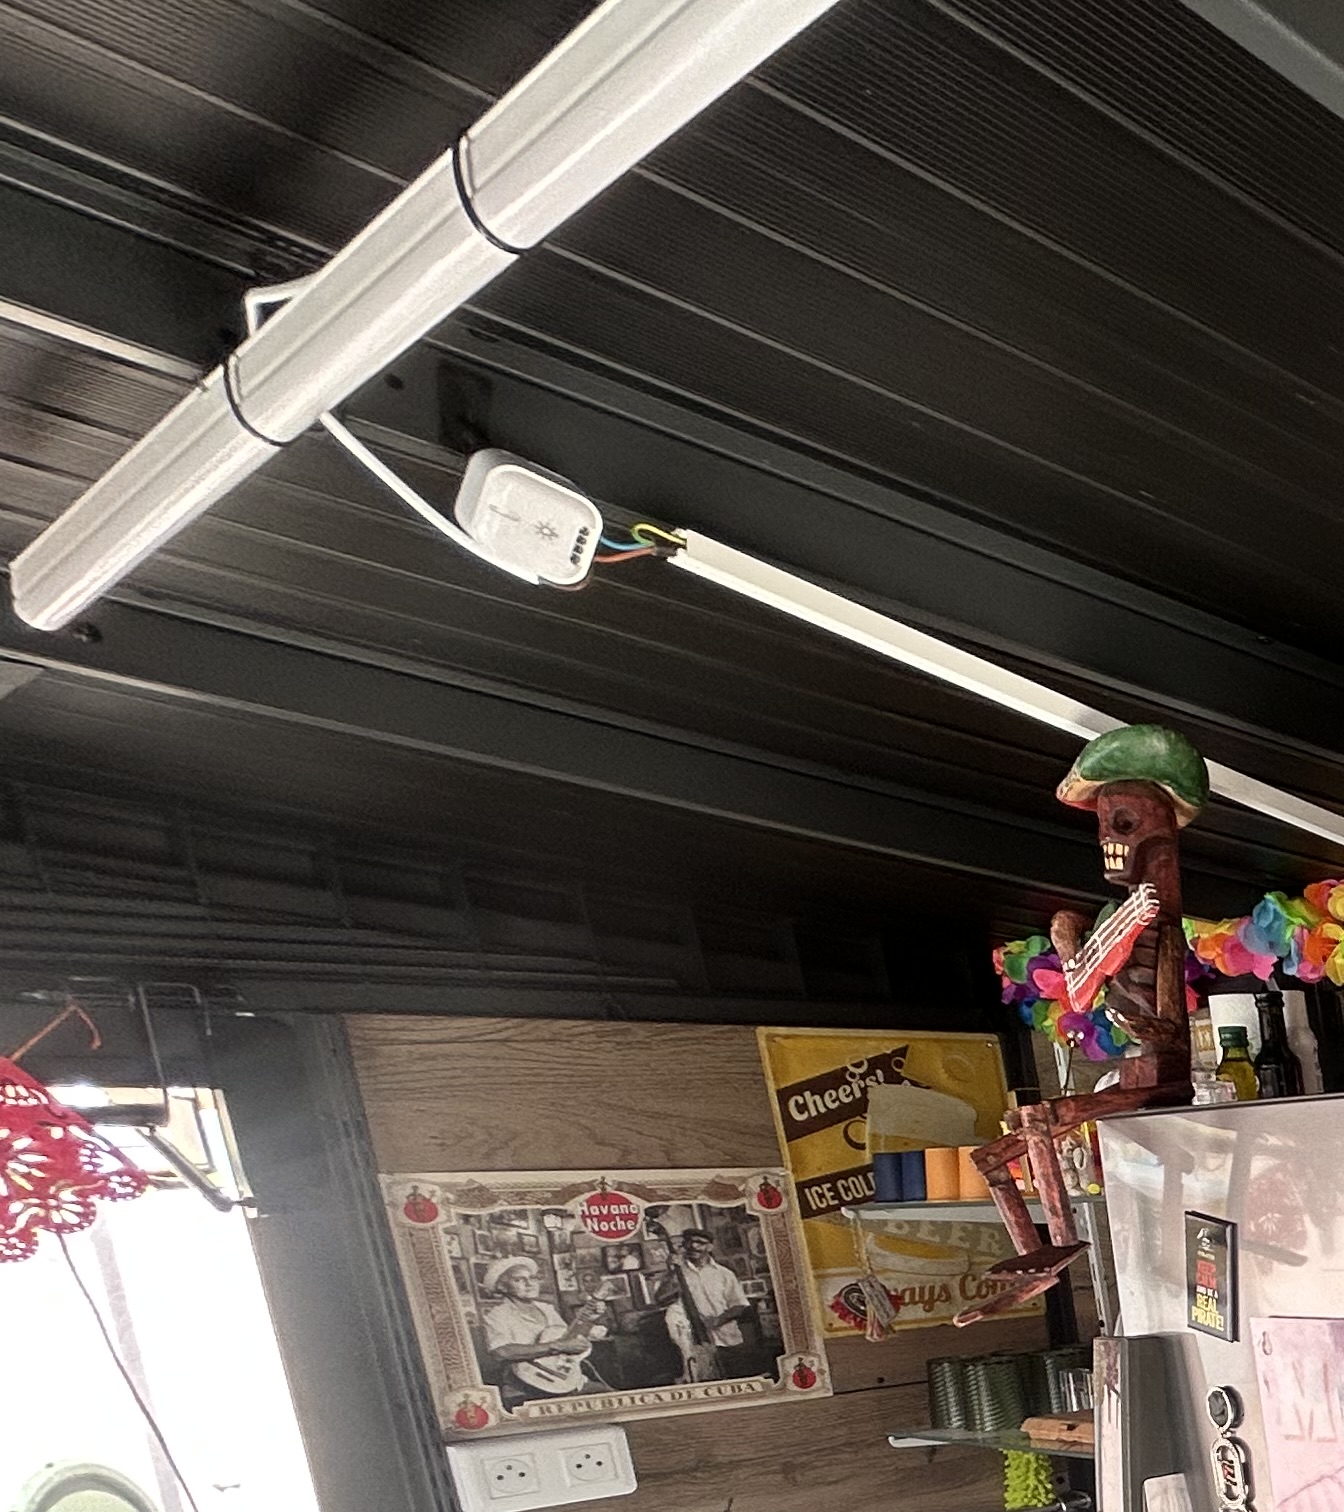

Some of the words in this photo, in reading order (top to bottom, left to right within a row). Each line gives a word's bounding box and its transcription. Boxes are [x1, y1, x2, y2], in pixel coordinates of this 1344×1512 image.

[805, 1182, 835, 1210] ICE
[579, 1201, 639, 1215] Havana
[586, 1216, 636, 1232] Noche
[1196, 1293, 1219, 1314] REAL
[1191, 1305, 1224, 1331] PIRATE!
[670, 1389, 693, 1400] DE
[703, 1382, 757, 1398] CUBA
